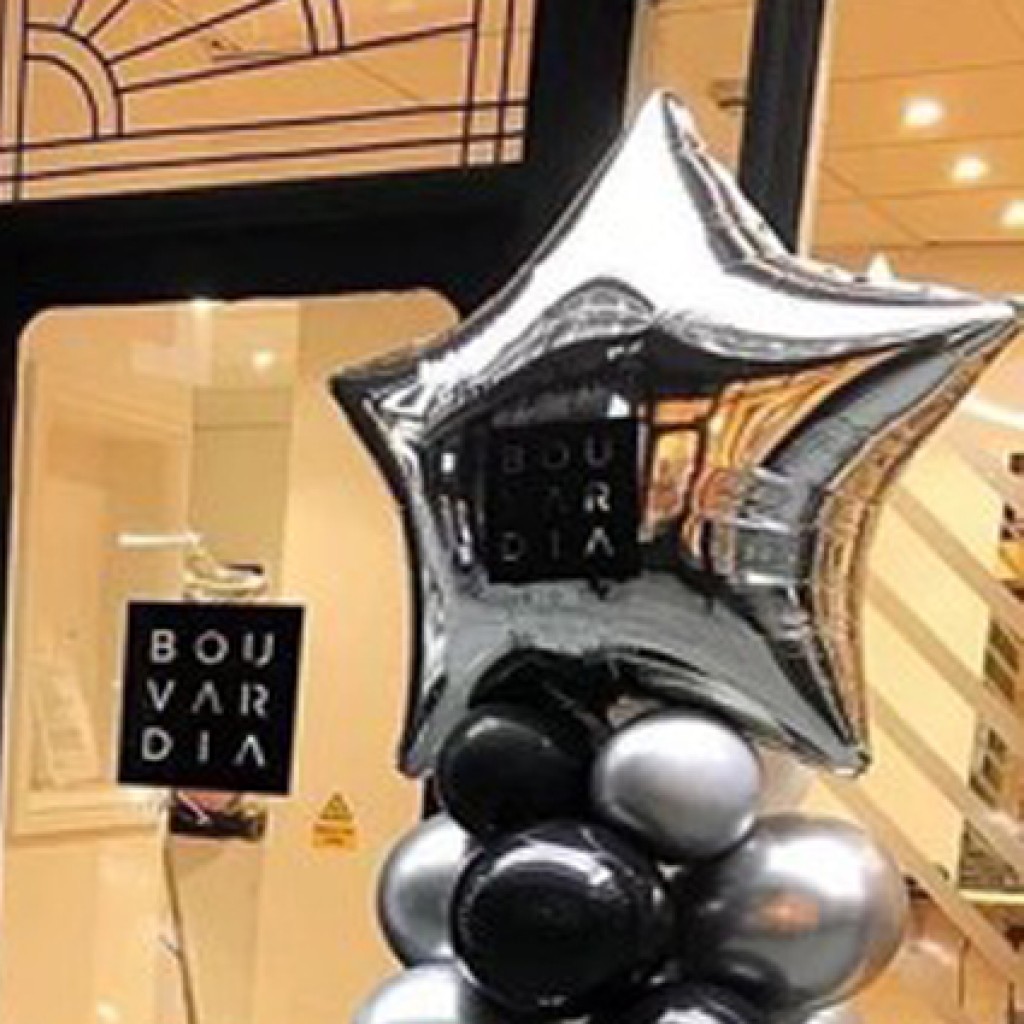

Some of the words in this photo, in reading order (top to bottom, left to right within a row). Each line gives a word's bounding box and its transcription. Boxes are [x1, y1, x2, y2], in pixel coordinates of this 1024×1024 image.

[149, 629, 275, 668] BOU
[145, 679, 271, 718] VAR
[140, 727, 267, 768] DIA
